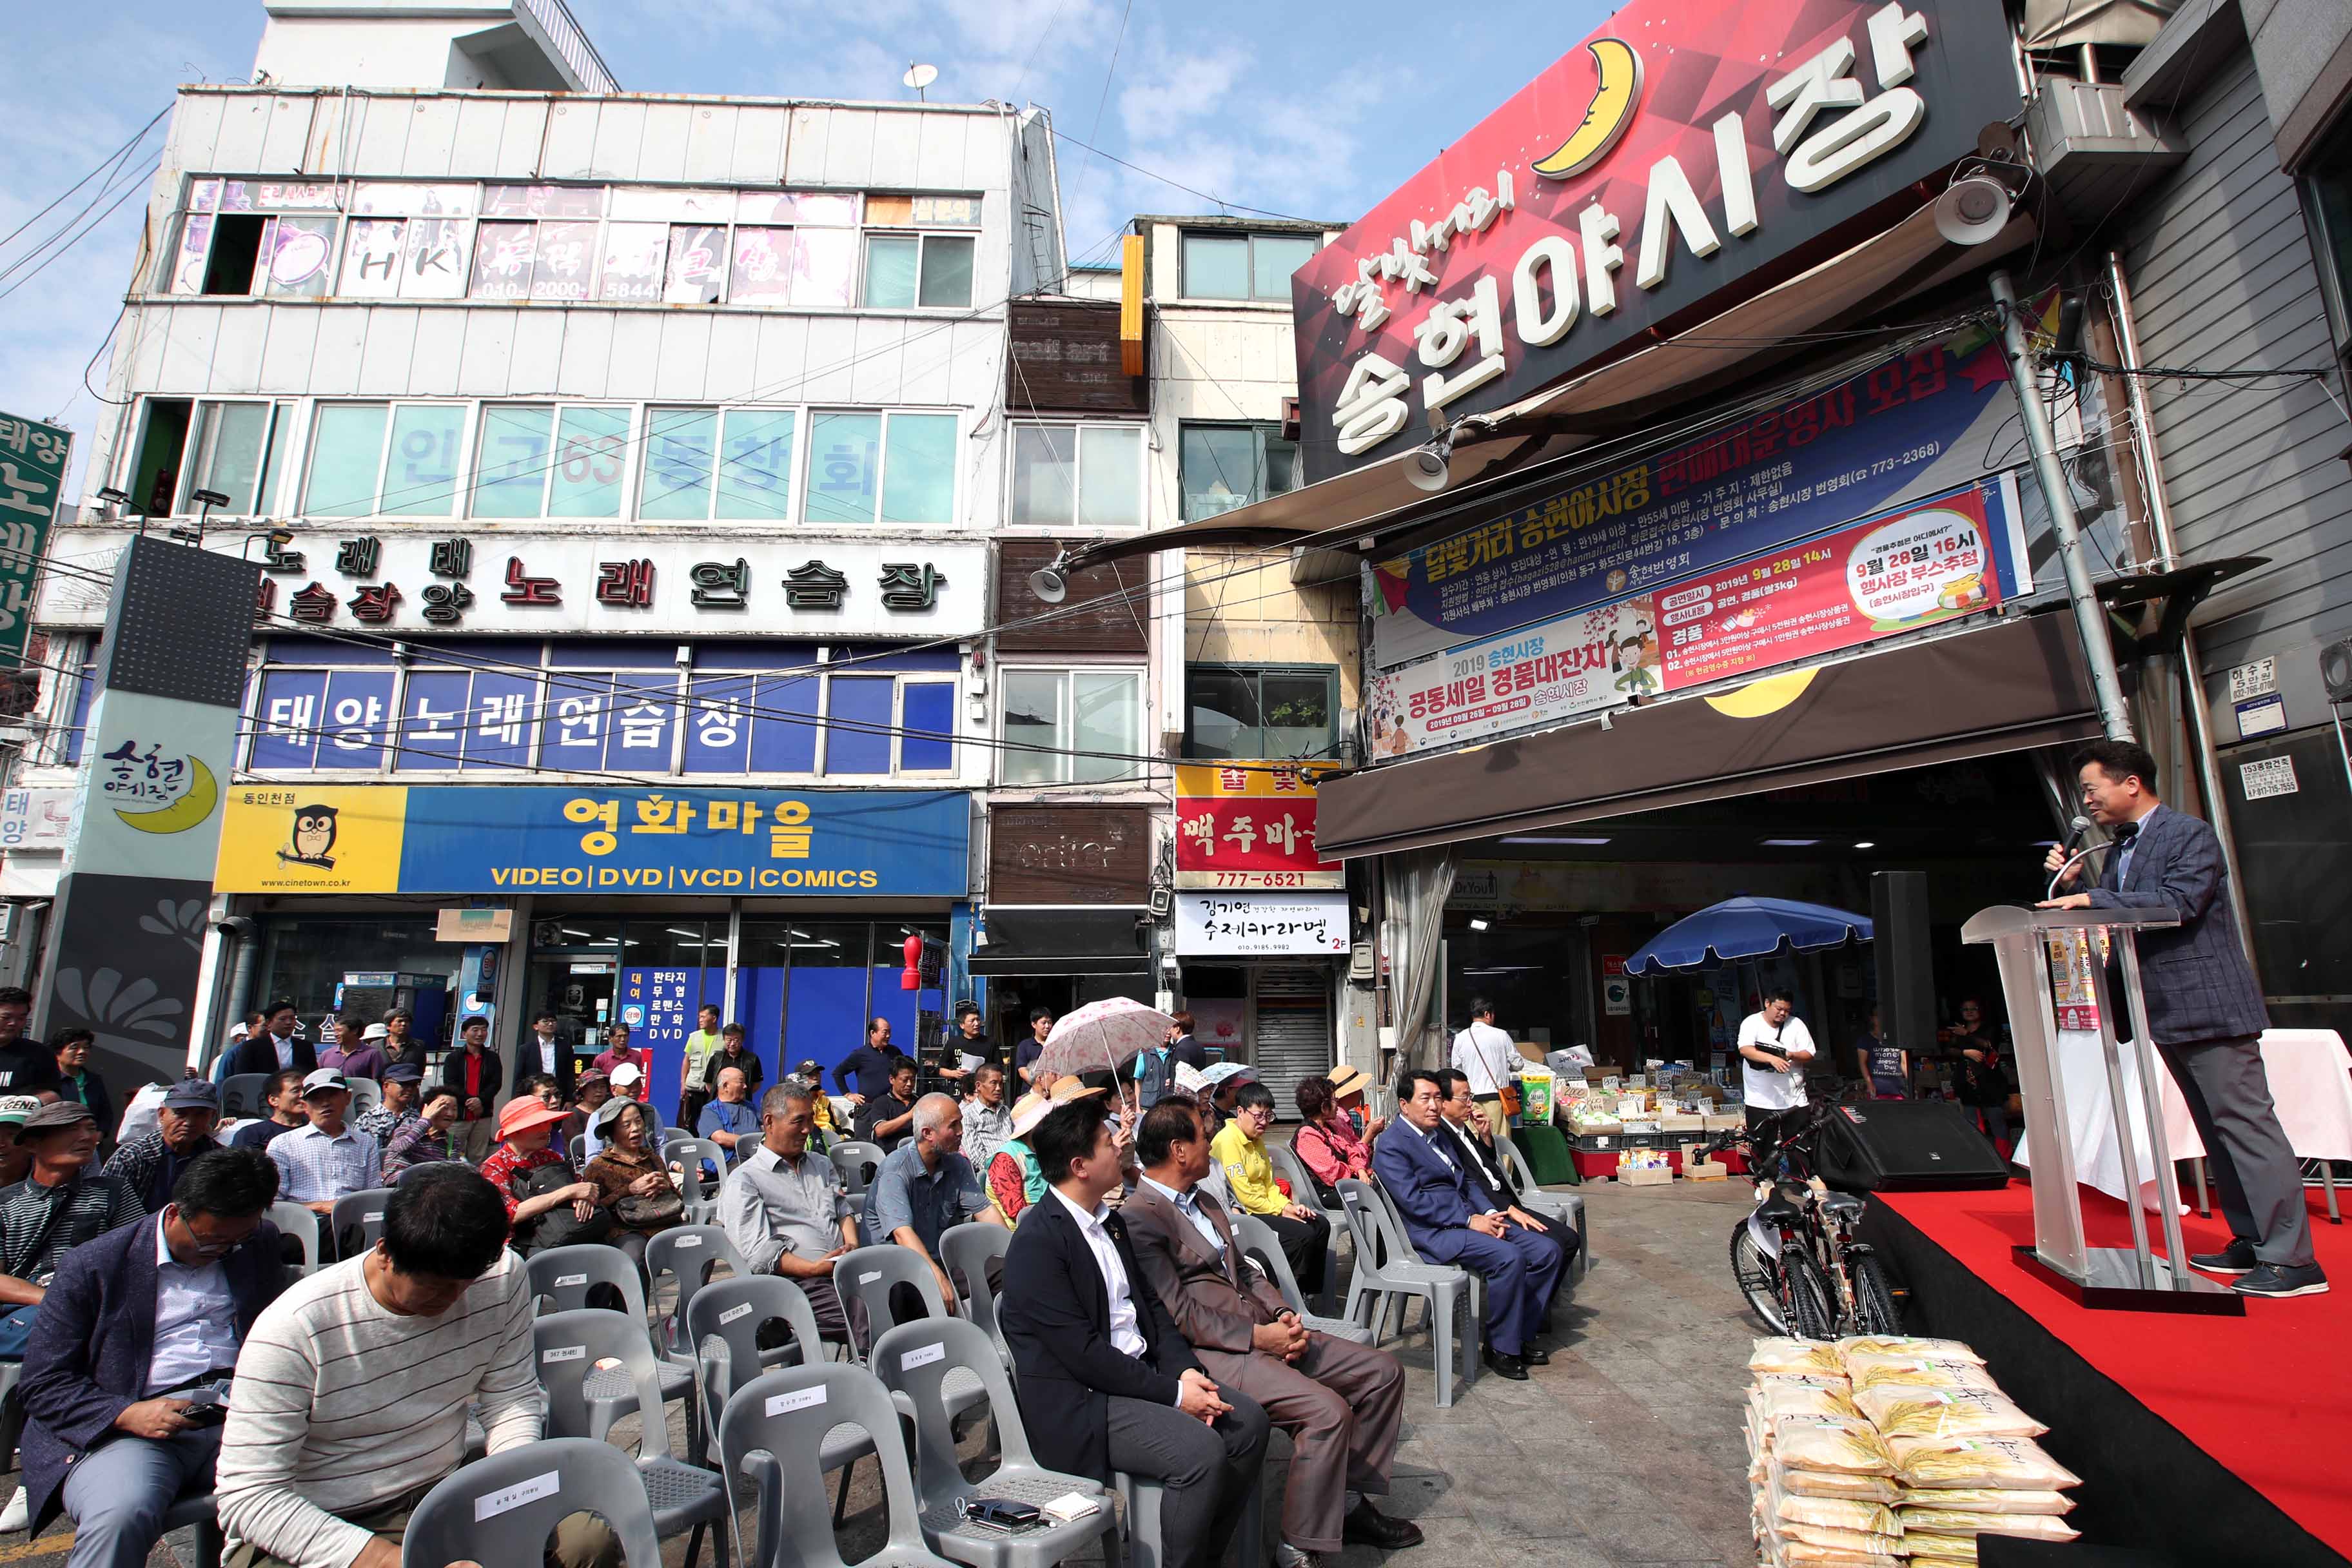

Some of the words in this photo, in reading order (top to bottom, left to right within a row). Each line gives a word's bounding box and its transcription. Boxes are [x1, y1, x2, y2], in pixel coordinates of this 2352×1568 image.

[1332, 1, 1929, 456] 송현야시장
[1331, 169, 1515, 333] 달빛거리
[1425, 518, 1513, 583] 달빛거리
[1519, 465, 1650, 549] 송현야시장
[1867, 344, 1946, 415] 모집
[1749, 461, 1792, 485] 제한없음
[1768, 488, 1812, 514] 송현시장
[1856, 557, 1884, 578] 9월
[1888, 544, 1930, 568] 28일
[1934, 530, 1975, 554] 16시
[1859, 570, 1908, 596] 행사장
[1910, 549, 1979, 580] 부스추첨
[500, 554, 949, 612] 노래연습장
[1669, 589, 1705, 607] 공연일시
[1716, 575, 1749, 593] 2019년
[1752, 568, 1772, 581] 9월
[1773, 558, 1802, 574] 28일
[1803, 548, 1832, 565] 14시
[1672, 624, 1703, 646] 경품
[1453, 654, 1485, 678] 2019
[1488, 636, 1545, 669] 송현시장
[1409, 674, 1487, 720] 공동세일
[1491, 640, 1607, 697] 경품대잔치
[244, 792, 297, 806] 동인천점
[562, 794, 815, 859] 영화마을
[1182, 812, 1317, 857] 맥주마
[261, 877, 351, 889] www.cinetown.co.kr
[1216, 872, 1306, 887] 777-6521
[653, 972, 686, 984] 판타지
[651, 1000, 684, 1012] 로맨스
[1226, 1162, 1244, 1179] 73
